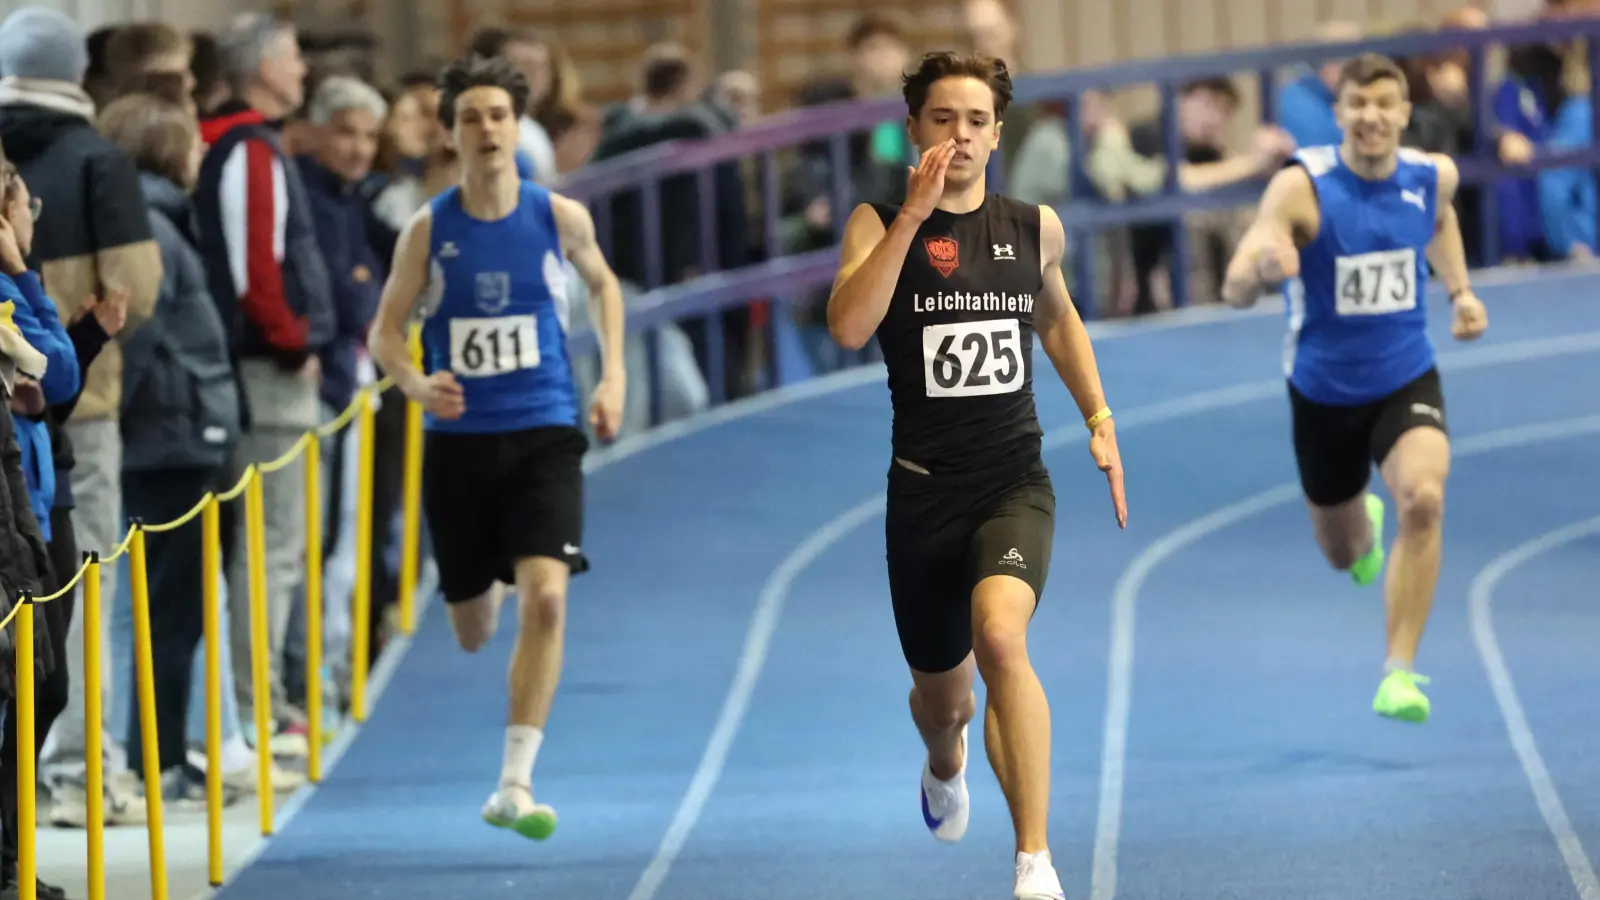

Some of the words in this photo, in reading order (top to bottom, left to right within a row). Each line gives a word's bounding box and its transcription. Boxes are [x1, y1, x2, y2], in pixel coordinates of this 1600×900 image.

[914, 291, 1034, 313] Leichtathletik
[1342, 260, 1409, 305] 473
[462, 326, 521, 370] 611
[932, 330, 1018, 389] 625
